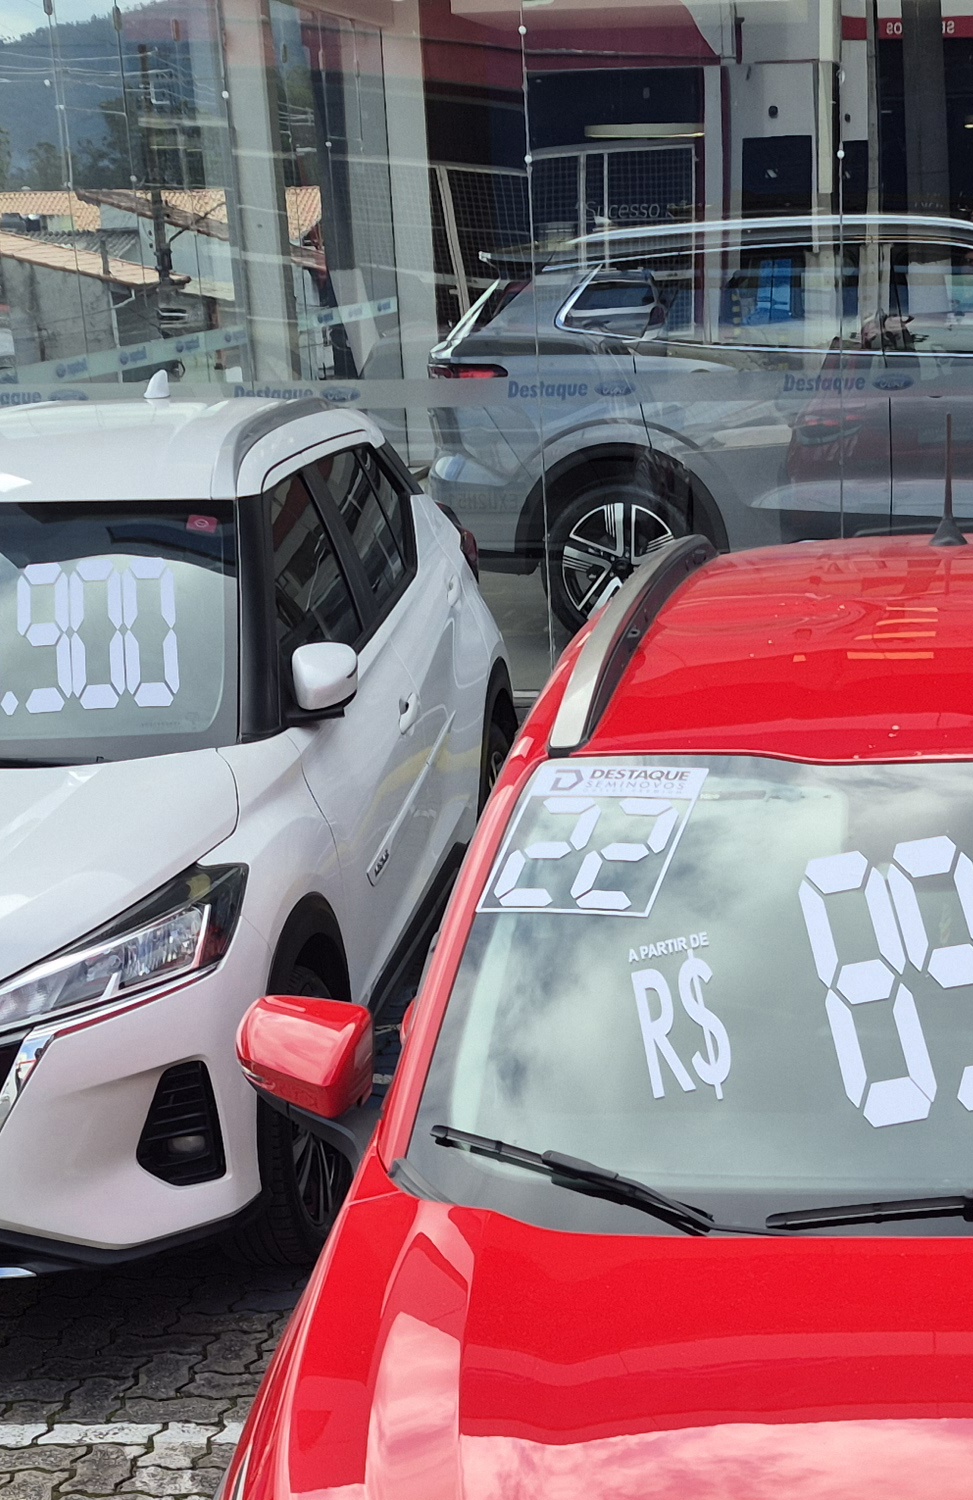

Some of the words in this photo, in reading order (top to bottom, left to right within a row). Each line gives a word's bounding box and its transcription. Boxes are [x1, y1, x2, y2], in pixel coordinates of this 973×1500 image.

[507, 380, 588, 400] Destaque
[783, 373, 865, 393] Destaque
[585, 780, 685, 790] SEMINOVOS
[589, 769, 691, 782] DESTAQUE
[493, 797, 679, 911] 22
[628, 948, 639, 963] A
[639, 936, 688, 960] PARTIR
[689, 931, 709, 948] DE
[631, 949, 731, 1100] R$
